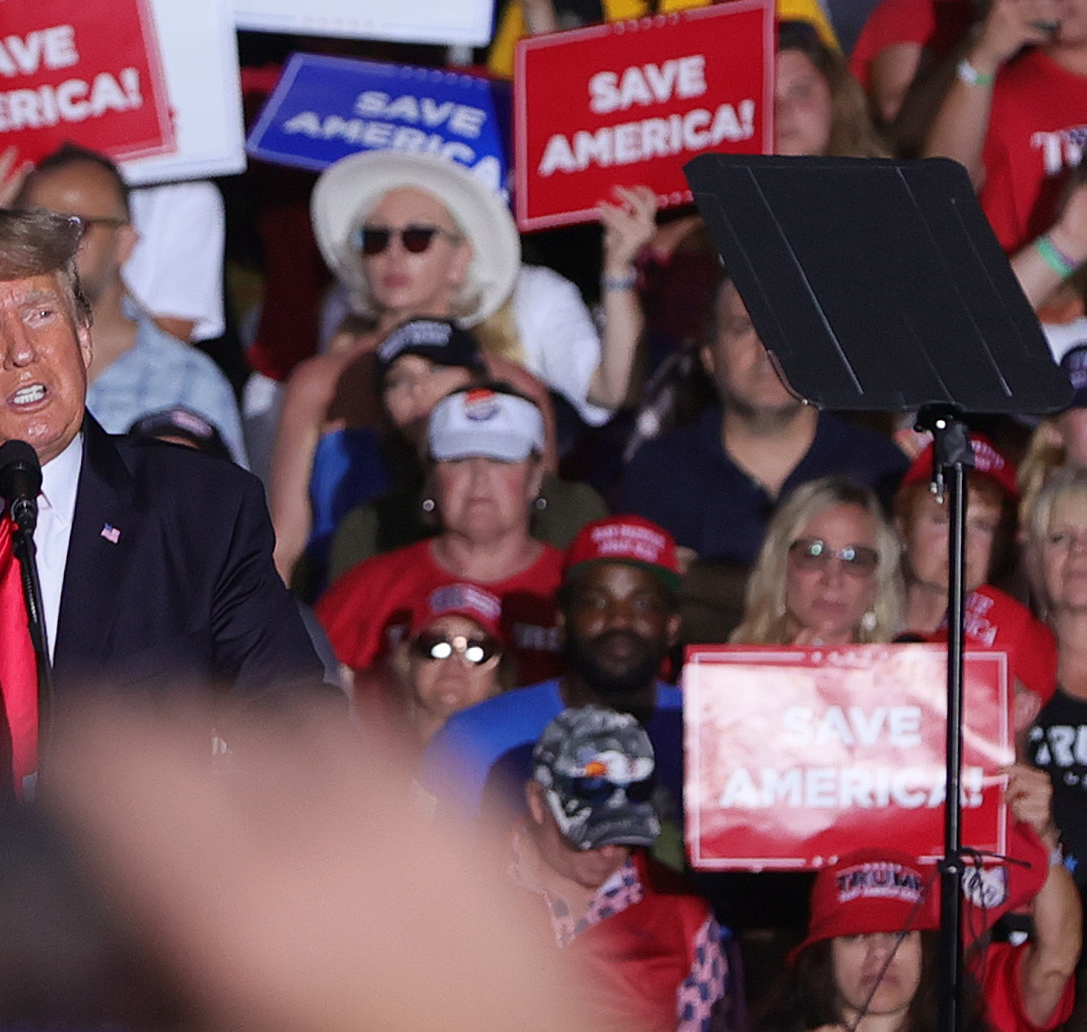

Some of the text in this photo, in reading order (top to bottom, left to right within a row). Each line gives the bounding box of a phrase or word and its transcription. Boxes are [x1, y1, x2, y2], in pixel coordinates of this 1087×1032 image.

[588, 54, 708, 114] SAVE
[355, 91, 487, 139] SAVE
[537, 100, 755, 176] AMERICA!
[782, 706, 922, 746] SAVE
[720, 767, 983, 808] AMERICA!
